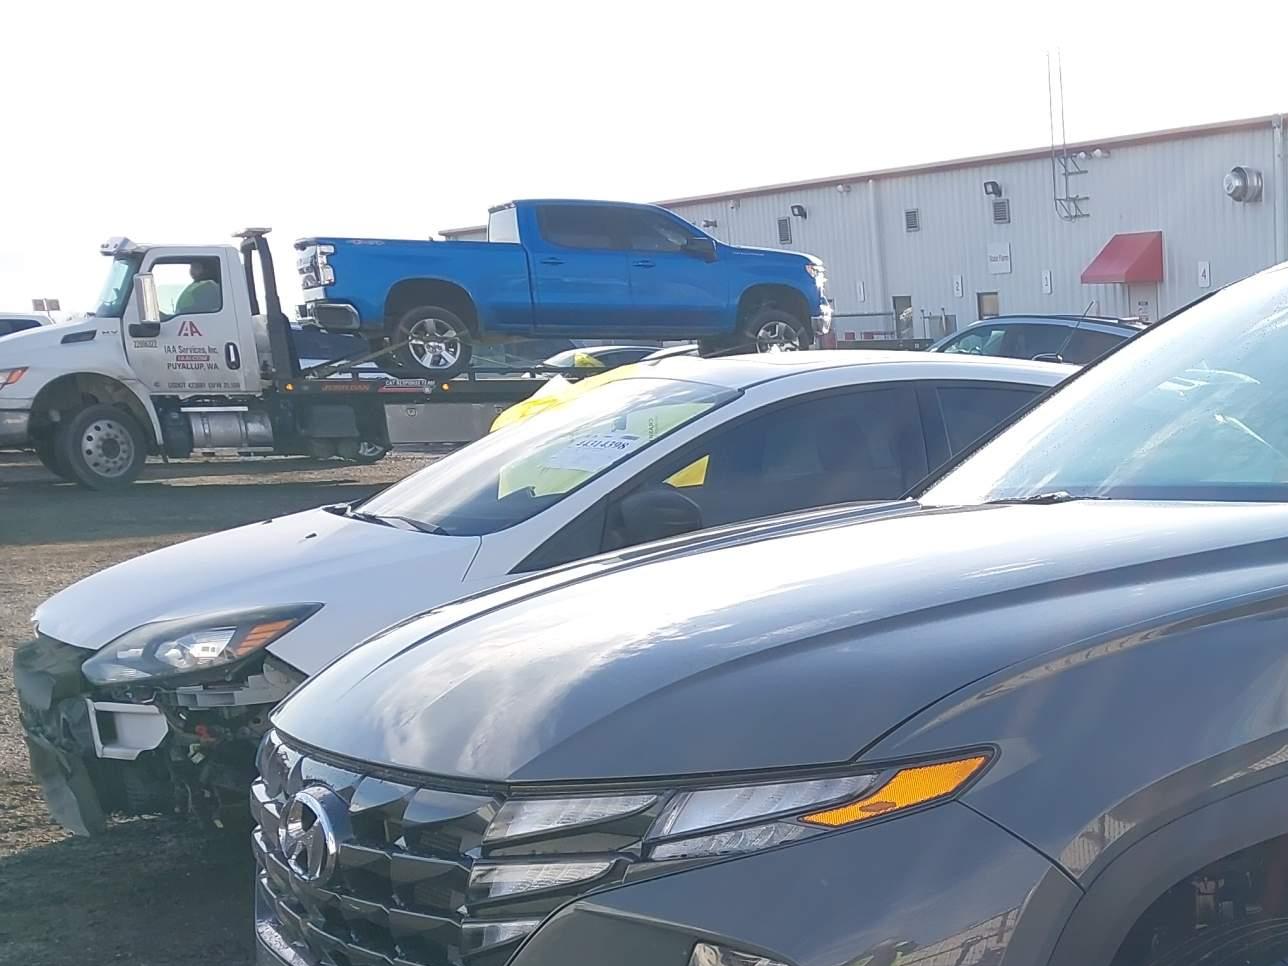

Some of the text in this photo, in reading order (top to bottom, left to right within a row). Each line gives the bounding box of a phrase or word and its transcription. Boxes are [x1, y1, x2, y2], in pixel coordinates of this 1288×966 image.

[1201, 267, 1207, 280] 4
[164, 345, 177, 354] IAA
[168, 362, 218, 372] PUYALLUP, WA
